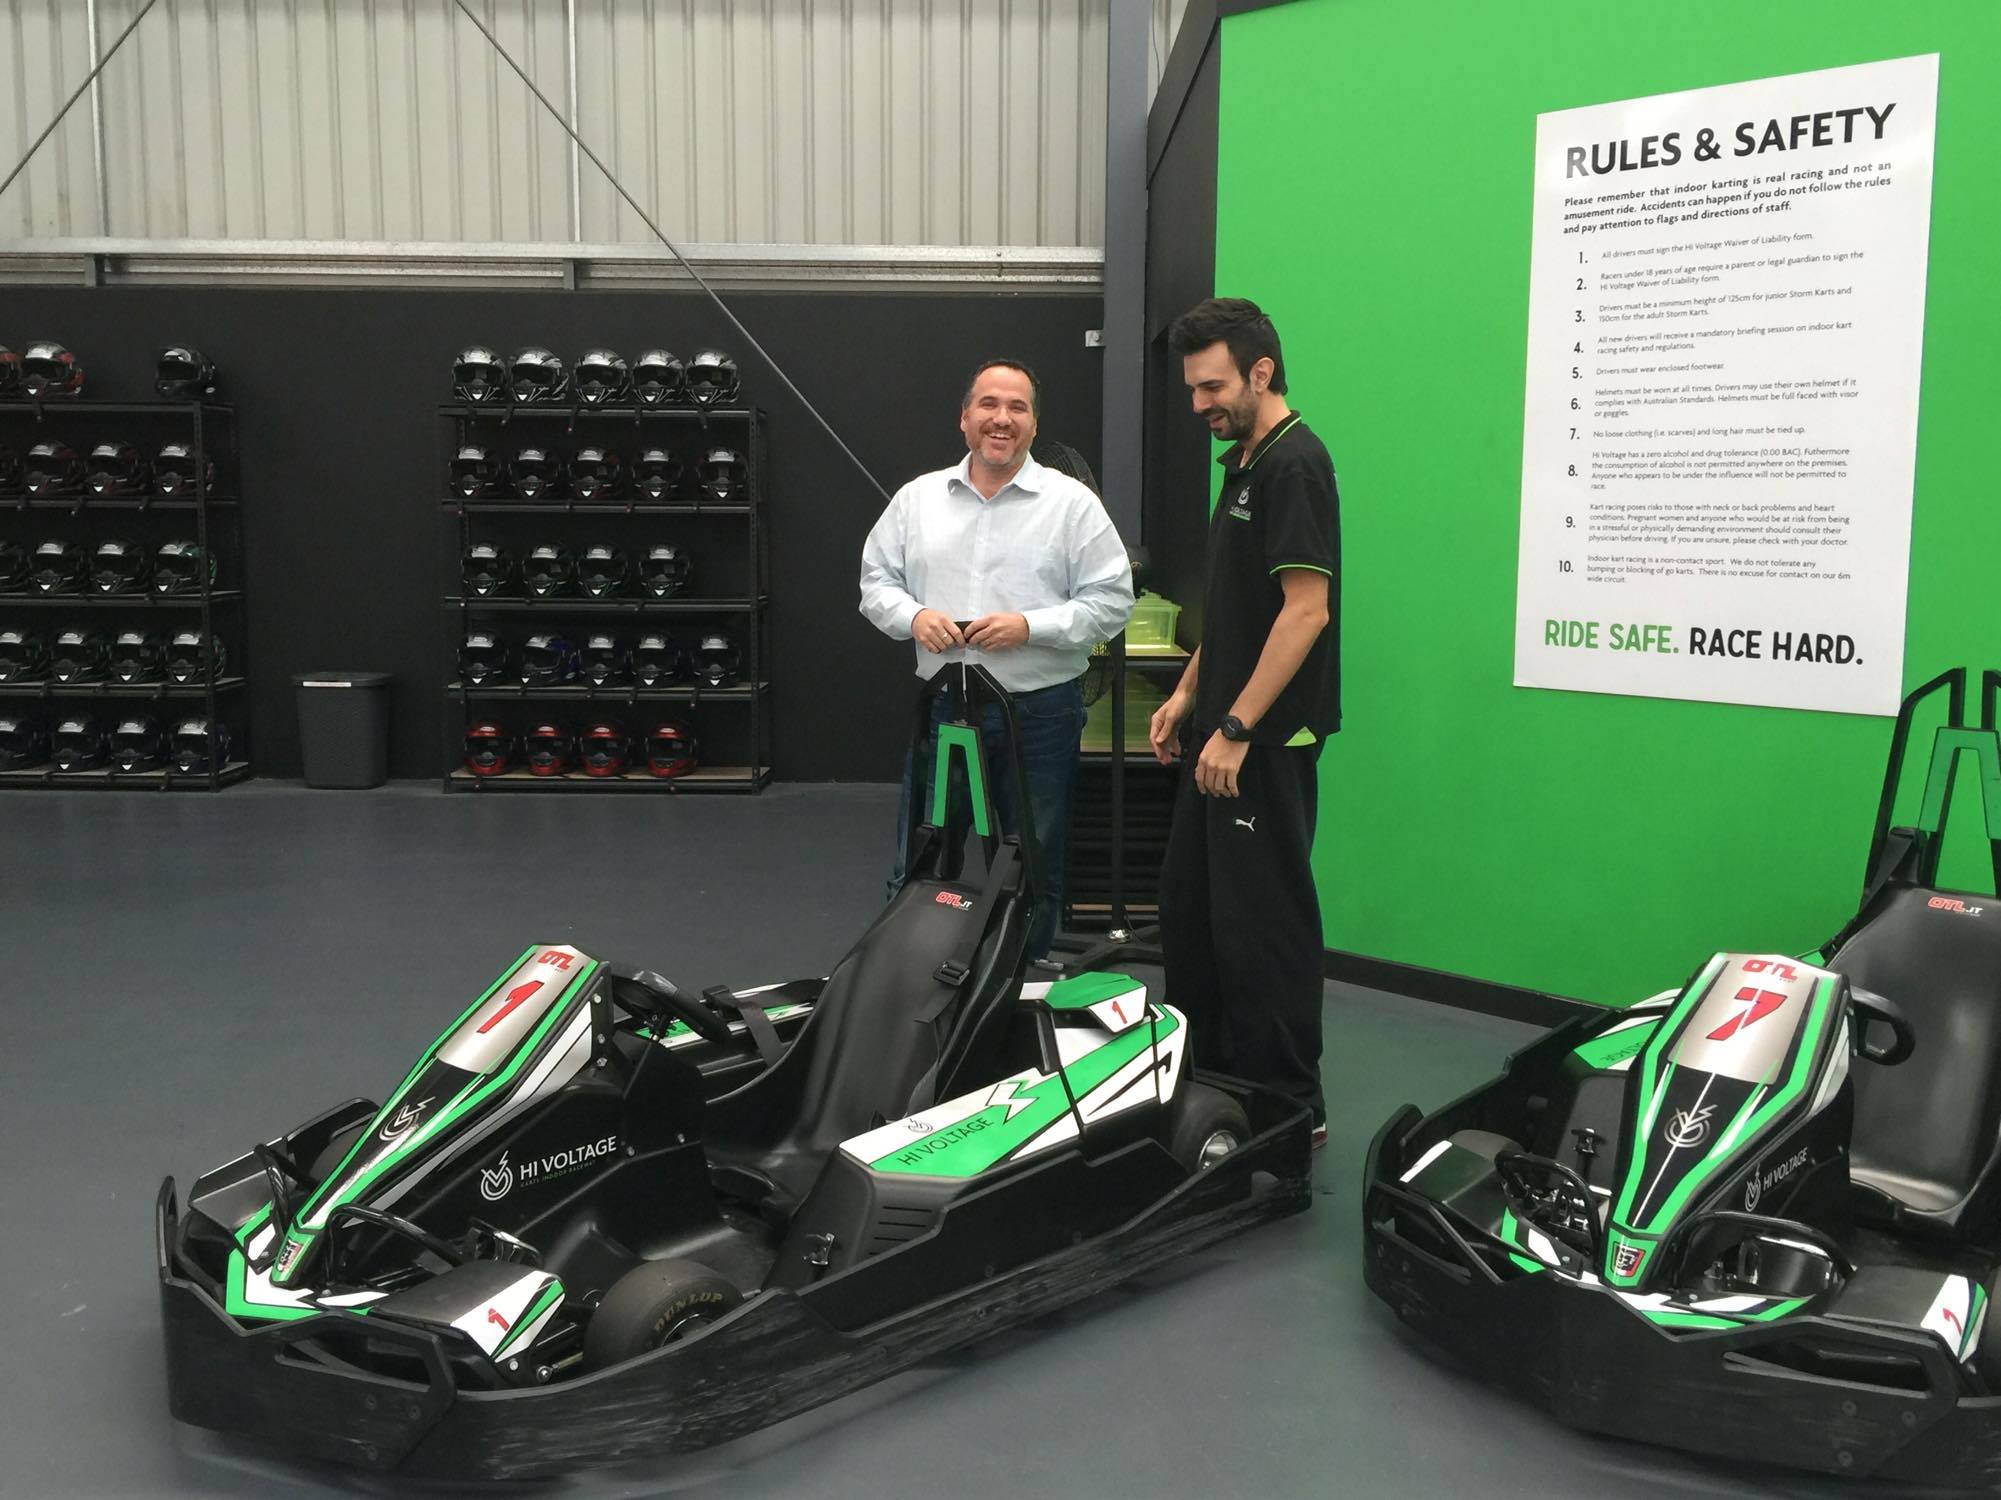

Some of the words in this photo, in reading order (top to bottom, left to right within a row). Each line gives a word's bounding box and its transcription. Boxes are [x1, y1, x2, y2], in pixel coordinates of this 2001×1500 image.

[1566, 130, 1682, 179] RULES
[1693, 125, 1723, 163] &
[1733, 101, 1896, 158] SAFETY
[1564, 194, 1593, 206] Please
[1597, 188, 1645, 202] remember
[1649, 185, 1669, 196] that
[1674, 180, 1707, 193] indoor
[1711, 176, 1748, 192] karting
[1752, 174, 1761, 184] is
[1765, 171, 1785, 183] real
[1790, 167, 1823, 183] racing
[1828, 164, 1848, 176] and
[1853, 161, 1872, 173] not
[1877, 162, 1891, 170] an
[1564, 205, 1614, 219] amusement
[1616, 203, 1636, 214] ride.
[1640, 197, 1685, 211] Accidents
[1687, 198, 1704, 206] can
[1705, 191, 1741, 207] happen
[1743, 190, 1751, 200] if
[1753, 191, 1771, 202] you
[1773, 186, 1787, 197] do
[1789, 184, 1806, 195] not
[1808, 180, 1842, 193] follow
[1844, 178, 1862, 189] the
[1864, 174, 1891, 187] rules
[1563, 223, 1579, 233] and
[1581, 224, 1597, 234] pay
[1599, 216, 1641, 229] attention
[1644, 215, 1654, 225] to
[1656, 212, 1678, 226] flags
[1681, 210, 1698, 221] and
[1700, 205, 1749, 219] directions
[1752, 203, 1763, 214] of
[1765, 200, 1791, 212] staff.
[1602, 249, 1611, 258] All
[1612, 247, 1636, 257] drivers
[1636, 245, 1654, 255] must
[1655, 244, 1670, 256] sign
[1671, 242, 1683, 252] the
[1684, 242, 1693, 250] Hi
[1694, 239, 1722, 252] Voltage
[1723, 236, 1749, 247] Waiver
[1750, 235, 1759, 244] of
[1761, 232, 1791, 246] Liability
[1579, 250, 1588, 264] 1.
[1600, 270, 1622, 279] Racers
[1624, 268, 1644, 278] under
[1645, 267, 1653, 276] 18
[1654, 268, 1672, 278] years
[1673, 265, 1682, 273] of
[1683, 266, 1696, 275] age
[1697, 261, 1723, 274] require
[1730, 258, 1755, 271] parent
[1767, 256, 1785, 268] legal
[1786, 253, 1820, 267] guardian
[1822, 252, 1831, 261] to
[1832, 250, 1848, 263] sign
[1850, 249, 1864, 259] the
[1576, 276, 1587, 290] 2.
[1600, 282, 1608, 290] Hi
[1609, 279, 1635, 292] Voltage
[1636, 277, 1660, 287] Waiver
[1661, 276, 1670, 285] of
[1670, 274, 1699, 287] Liability
[1599, 302, 1623, 311] Drivers
[1624, 301, 1641, 309] must
[1642, 300, 1652, 308] be
[1658, 297, 1692, 307] minimum
[1693, 295, 1716, 307] height
[1717, 294, 1726, 303] of
[1727, 292, 1751, 302] 125cm
[1752, 291, 1763, 300] for
[1764, 290, 1787, 302] junior
[1788, 288, 1813, 298] Storm
[1814, 286, 1835, 296] Karts
[1836, 285, 1852, 294] and
[1575, 309, 1585, 323] 3.
[1597, 335, 1607, 343] All
[1624, 332, 1647, 341] drivers
[1649, 332, 1661, 340] will
[1663, 330, 1688, 339] receive
[1695, 327, 1735, 339] mandatory
[1736, 325, 1765, 337] briefing
[1767, 323, 1794, 333] session
[1808, 321, 1834, 330] indoor
[1835, 320, 1851, 329] kart
[1573, 341, 1583, 353] 4.
[1572, 366, 1582, 379] 5.
[1570, 397, 1581, 410] 6.
[1569, 427, 1580, 440] 7.
[1567, 464, 1578, 476] 8.
[1591, 471, 1616, 481] Anyone
[1671, 470, 1680, 478] be
[1682, 470, 1703, 478] under
[1704, 470, 1717, 478] the
[1718, 470, 1752, 478] influence
[1784, 469, 1795, 477] be
[1795, 469, 1836, 480] permitted
[1837, 469, 1846, 477] to
[1604, 460, 1648, 470] consumption
[1693, 459, 1706, 467] not
[1707, 459, 1745, 469] permitted
[1746, 458, 1783, 469] anywhere
[1796, 458, 1810, 466] the
[1565, 514, 1575, 528] 9.
[1559, 559, 1573, 572] 10.
[1544, 618, 1599, 649] RIDE
[1608, 622, 1680, 654] SAFE.
[1689, 624, 1762, 659] RACE
[1772, 630, 1864, 665] HARD.
[476, 980, 545, 1034] 1
[1112, 1000, 1127, 1024] 1
[1705, 987, 1788, 1041] 7
[896, 1151, 920, 1167] HI
[917, 1116, 995, 1154] VOLTAGE
[520, 1160, 538, 1181] HI
[541, 1135, 617, 1174] VOLTAGE
[1763, 1171, 1773, 1192] HI
[1773, 1146, 1808, 1184] VOLTAGE
[487, 1308, 510, 1331] 1
